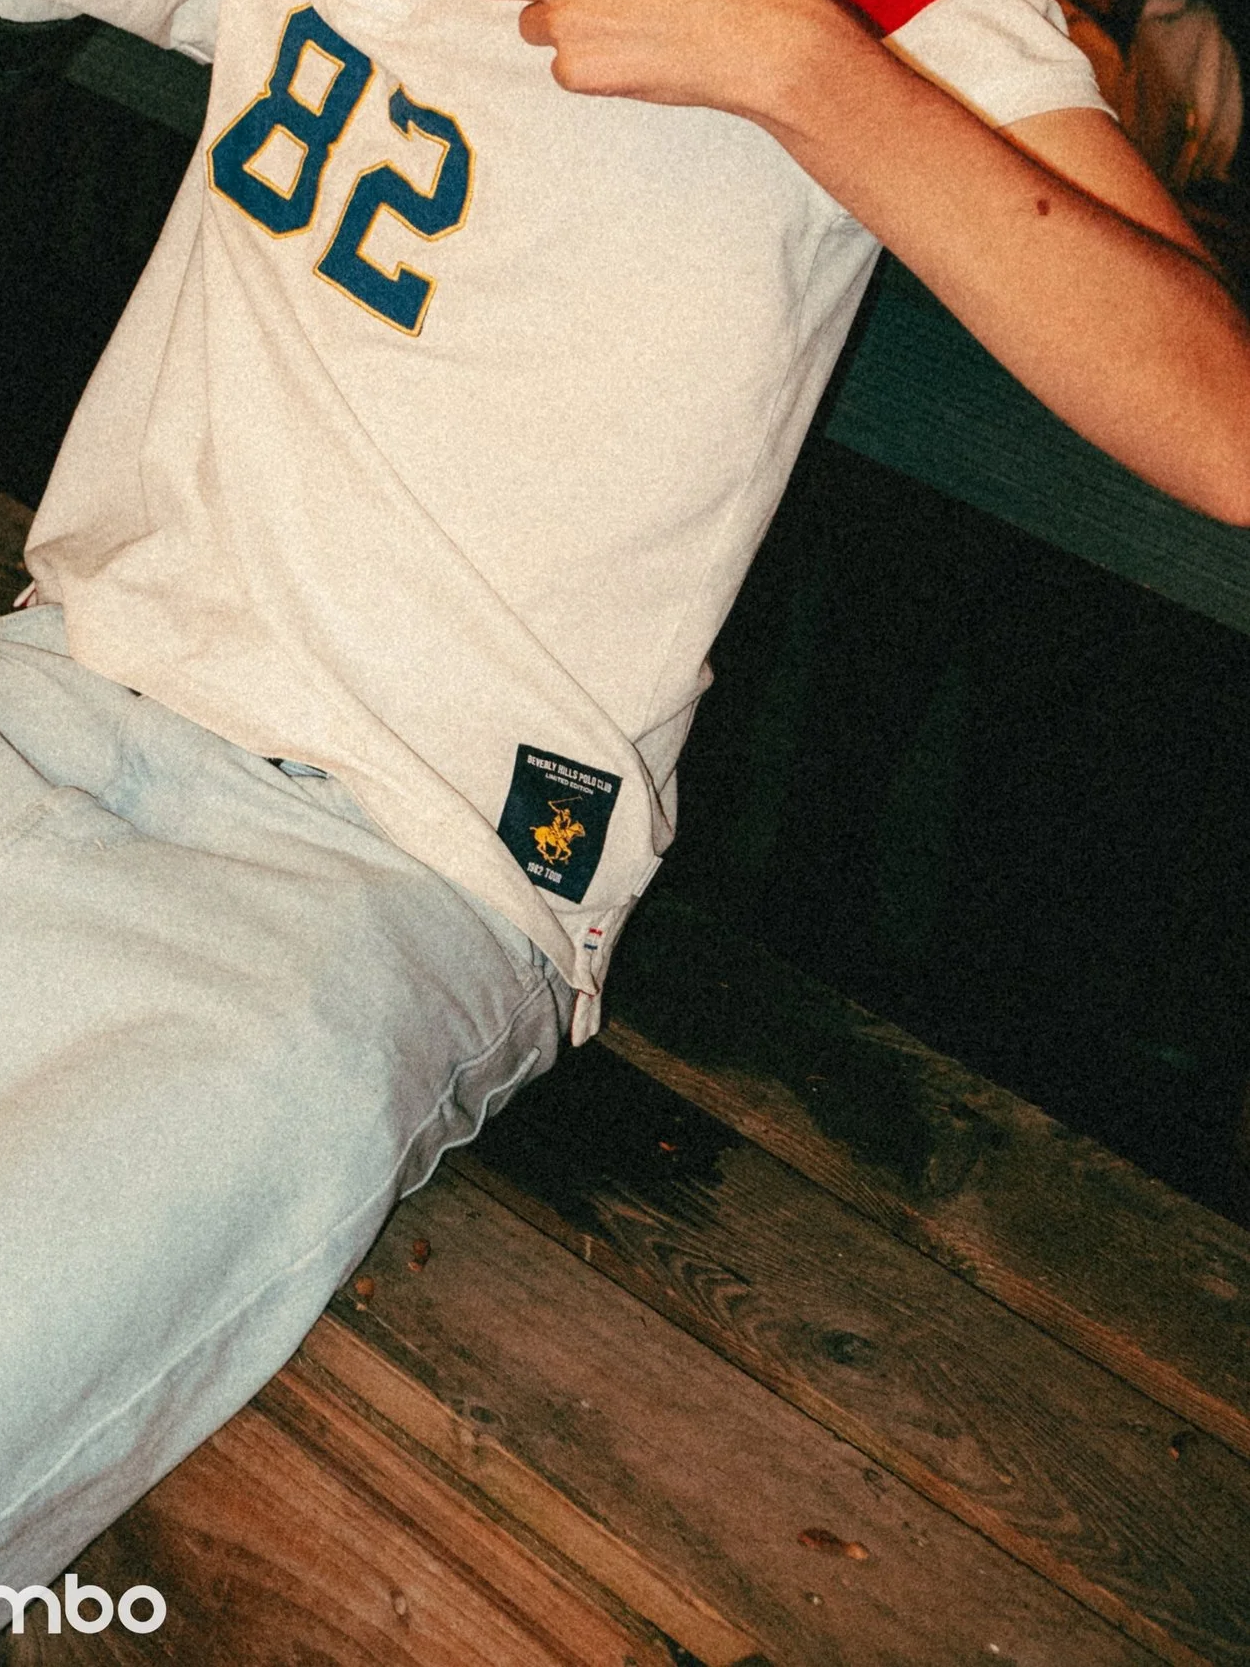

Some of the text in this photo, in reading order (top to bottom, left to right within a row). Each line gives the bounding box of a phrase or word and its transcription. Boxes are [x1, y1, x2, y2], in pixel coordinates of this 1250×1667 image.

[206, 2, 477, 337] 82
[526, 754, 613, 794] BEVERLY HILLS POLO CLUB
[545, 772, 594, 795] LIMITED EDITION
[544, 867, 563, 884] TOUR
